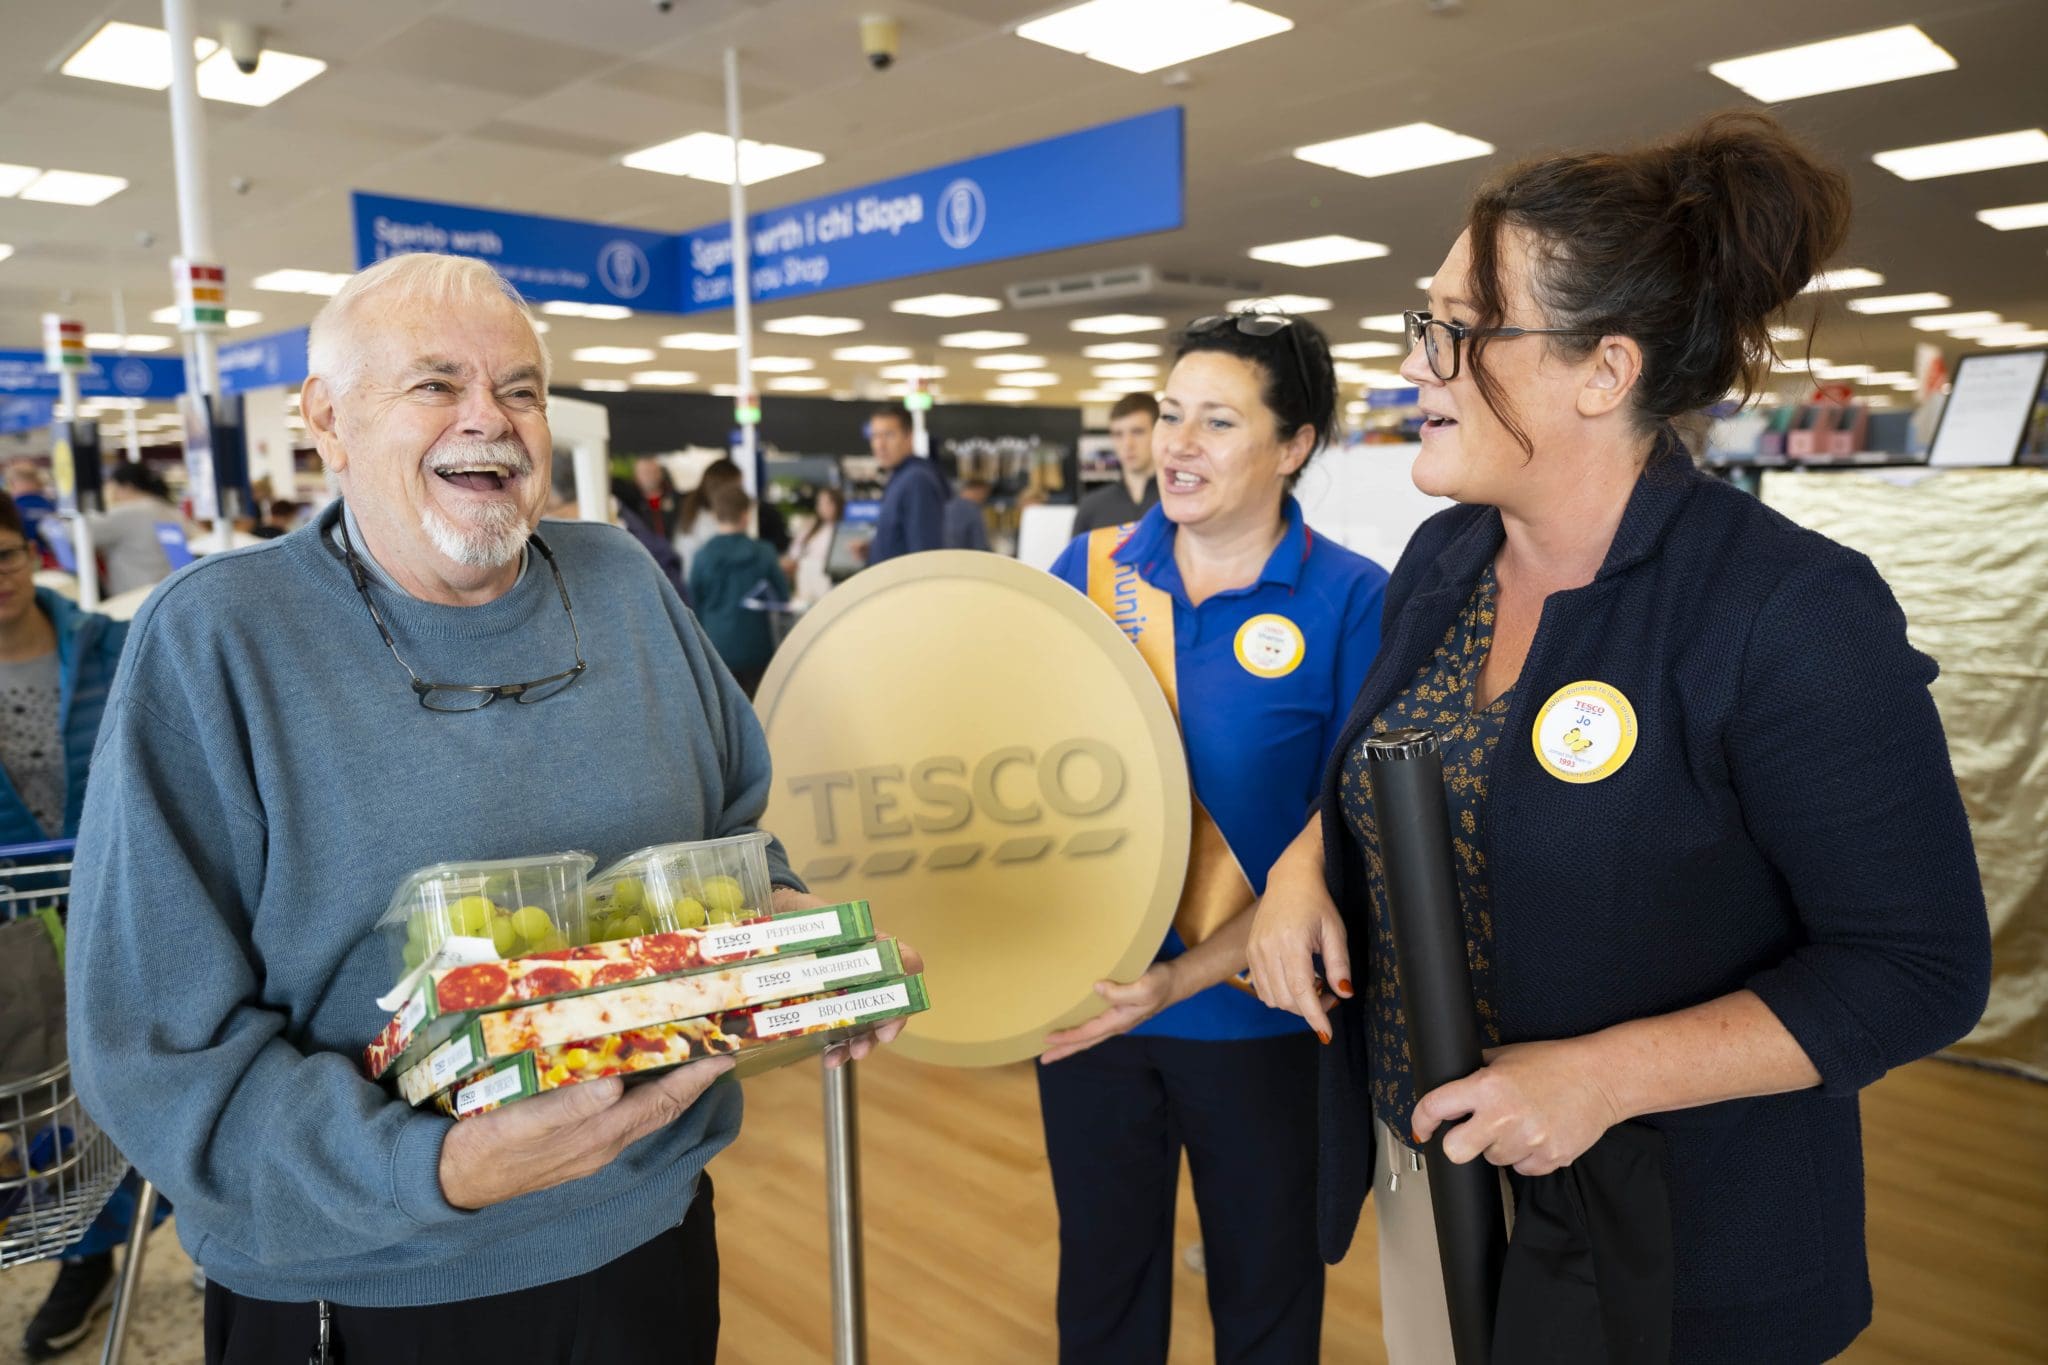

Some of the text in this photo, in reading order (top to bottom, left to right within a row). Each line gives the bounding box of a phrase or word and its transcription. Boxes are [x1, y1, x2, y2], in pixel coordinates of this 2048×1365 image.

[817, 202, 853, 242] chi
[856, 193, 923, 236] Siopa
[783, 256, 830, 287] Shop
[1575, 700, 1605, 715] TESCO
[1576, 715, 1591, 727] Jo
[786, 737, 1128, 846] TESCO
[715, 920, 825, 946] TESCO PEPPERONI
[756, 957, 872, 985] TESCO MARGHERITA
[767, 992, 896, 1025] TESCO BBQ CHICKEN
